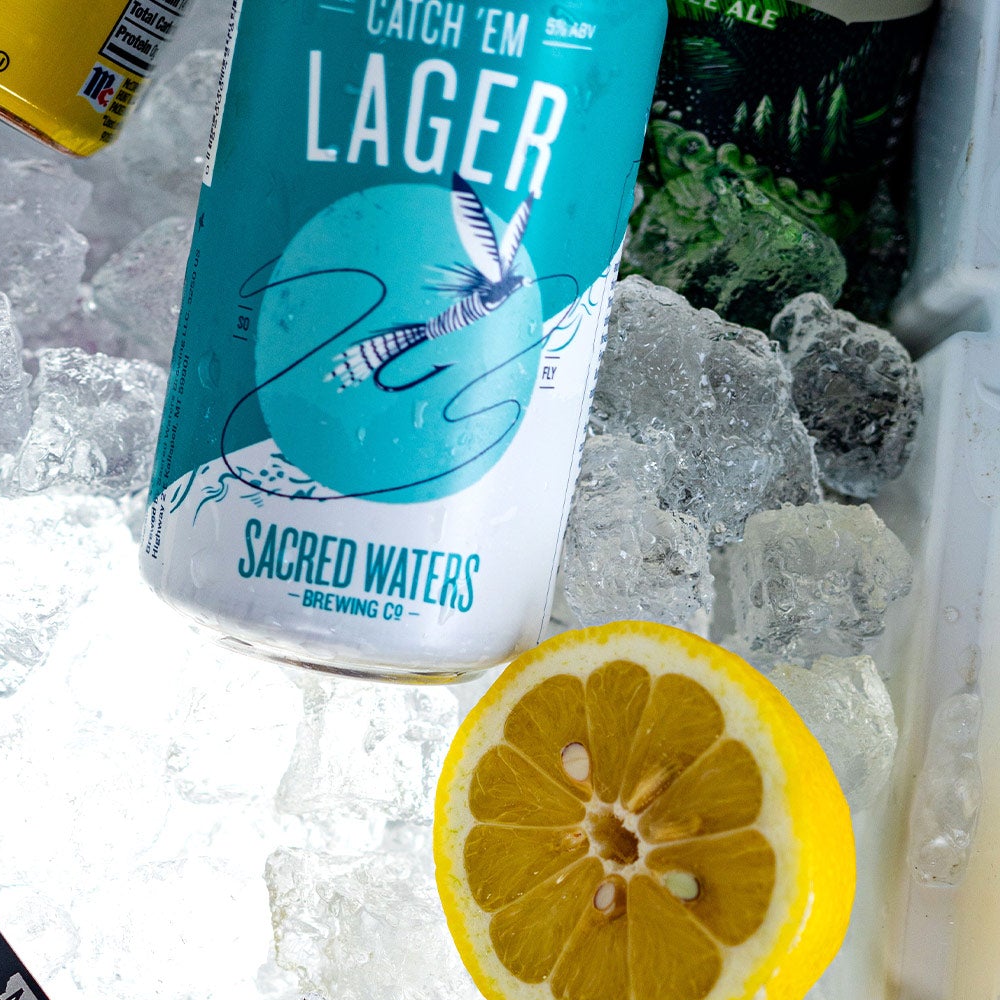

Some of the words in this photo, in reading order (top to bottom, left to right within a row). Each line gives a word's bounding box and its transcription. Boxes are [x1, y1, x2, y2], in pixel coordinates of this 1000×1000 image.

[130, 0, 158, 26] Total
[727, 0, 778, 28] ALE
[115, 24, 152, 56] Protein
[366, 0, 464, 48] CATCH
[475, 8, 529, 58] 'EM
[568, 22, 596, 39] ABV
[306, 50, 568, 200] LAGER
[541, 366, 557, 380] FLY
[152, 505, 166, 560] Highway
[174, 397, 182, 418] MT
[238, 518, 357, 589] SACRED
[364, 542, 480, 613] WATERS
[302, 589, 379, 618] BREWING
